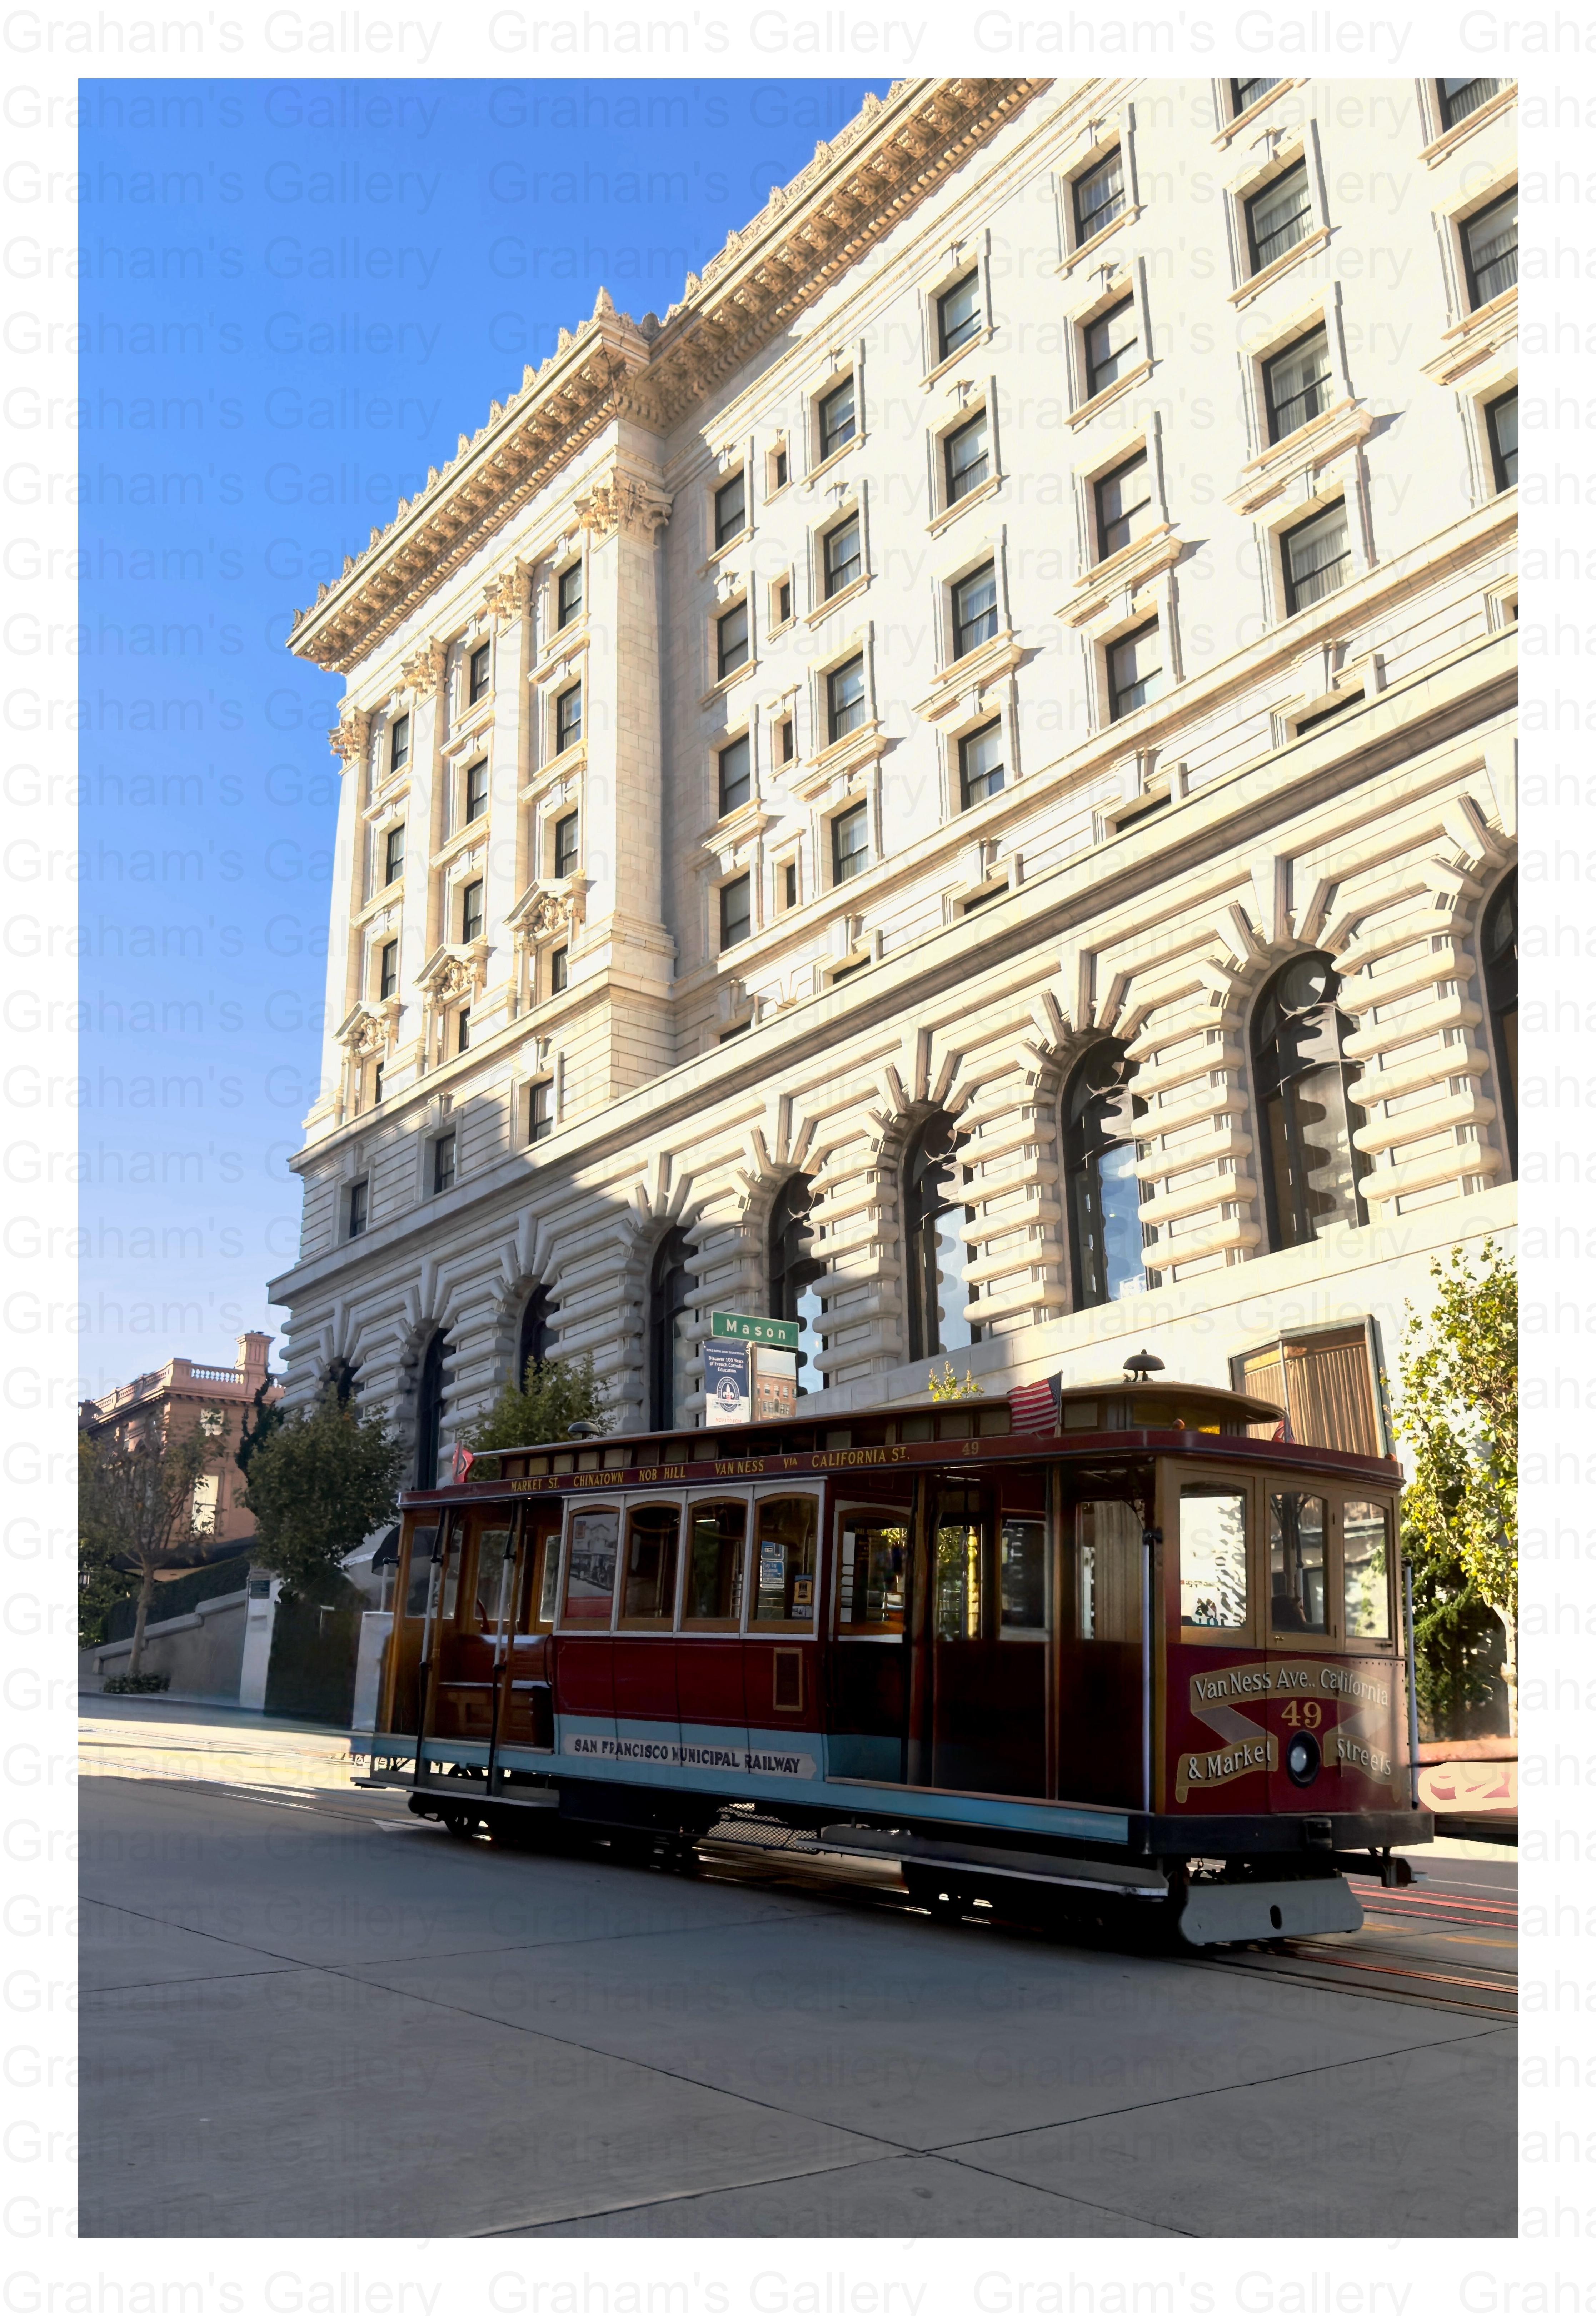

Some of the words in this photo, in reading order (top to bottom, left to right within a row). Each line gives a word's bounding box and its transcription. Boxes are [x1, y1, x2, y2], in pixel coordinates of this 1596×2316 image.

[726, 1319, 785, 1339] Mason
[512, 1478, 542, 1492] MARKET
[548, 1477, 559, 1488] ST.
[574, 1472, 623, 1487] CHINATOWN
[639, 1469, 657, 1482] NOB
[664, 1466, 686, 1479] HILL
[715, 1462, 734, 1475] VAN
[738, 1459, 764, 1473] NESS
[784, 1457, 797, 1469] VIA
[812, 1449, 886, 1467] CALIFORNIA
[962, 1442, 979, 1455] 49
[1195, 1678, 1227, 1701] Van
[1229, 1671, 1272, 1694] Ness
[1320, 1668, 1388, 1706] California
[1281, 1700, 1322, 1728] 49
[574, 1738, 597, 1753] SAN
[602, 1741, 668, 1760] FRANCISCO
[672, 1747, 740, 1767] MUNICIPAL
[745, 1754, 801, 1773] RAILWAY
[1188, 1756, 1202, 1780] &
[1207, 1741, 1271, 1778] Market
[1337, 1738, 1391, 1775] Streets
